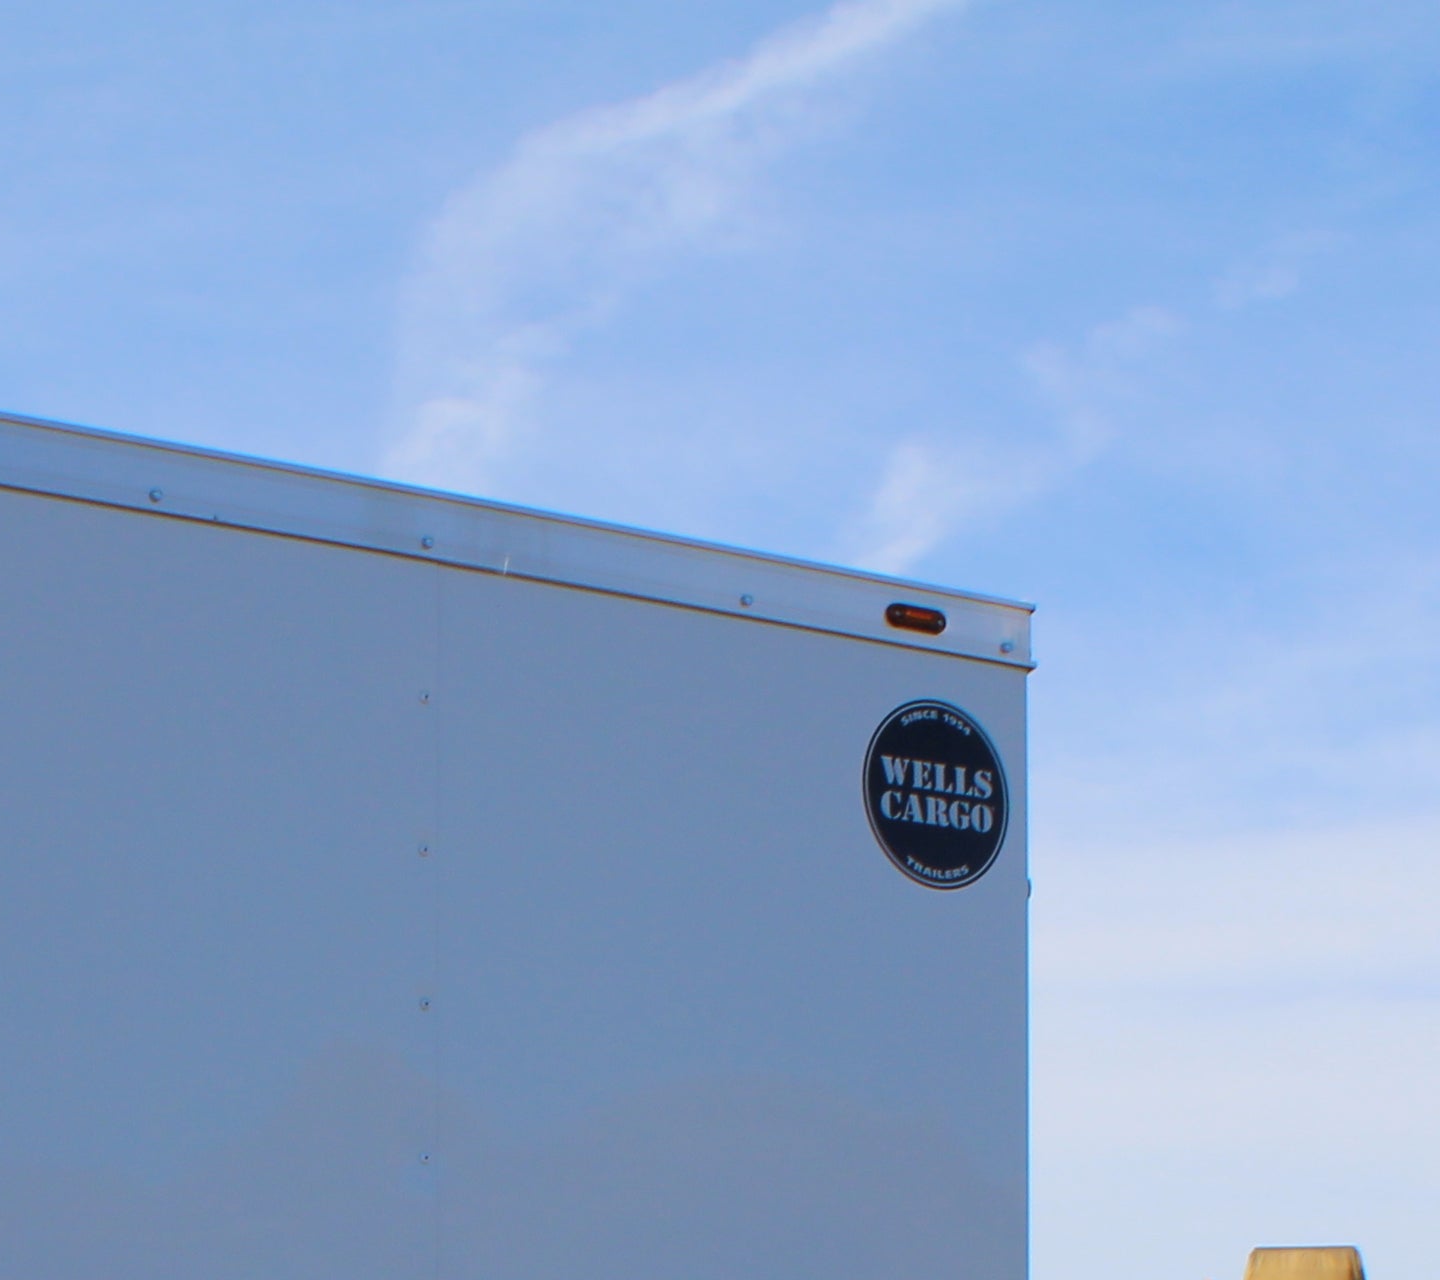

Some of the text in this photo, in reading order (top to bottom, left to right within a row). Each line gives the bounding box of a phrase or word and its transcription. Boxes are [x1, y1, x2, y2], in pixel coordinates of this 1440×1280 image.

[900, 709, 939, 727] SINCE
[880, 754, 993, 800] WELLS
[880, 790, 994, 834] CARGO
[905, 855, 970, 880] TRAILERS
